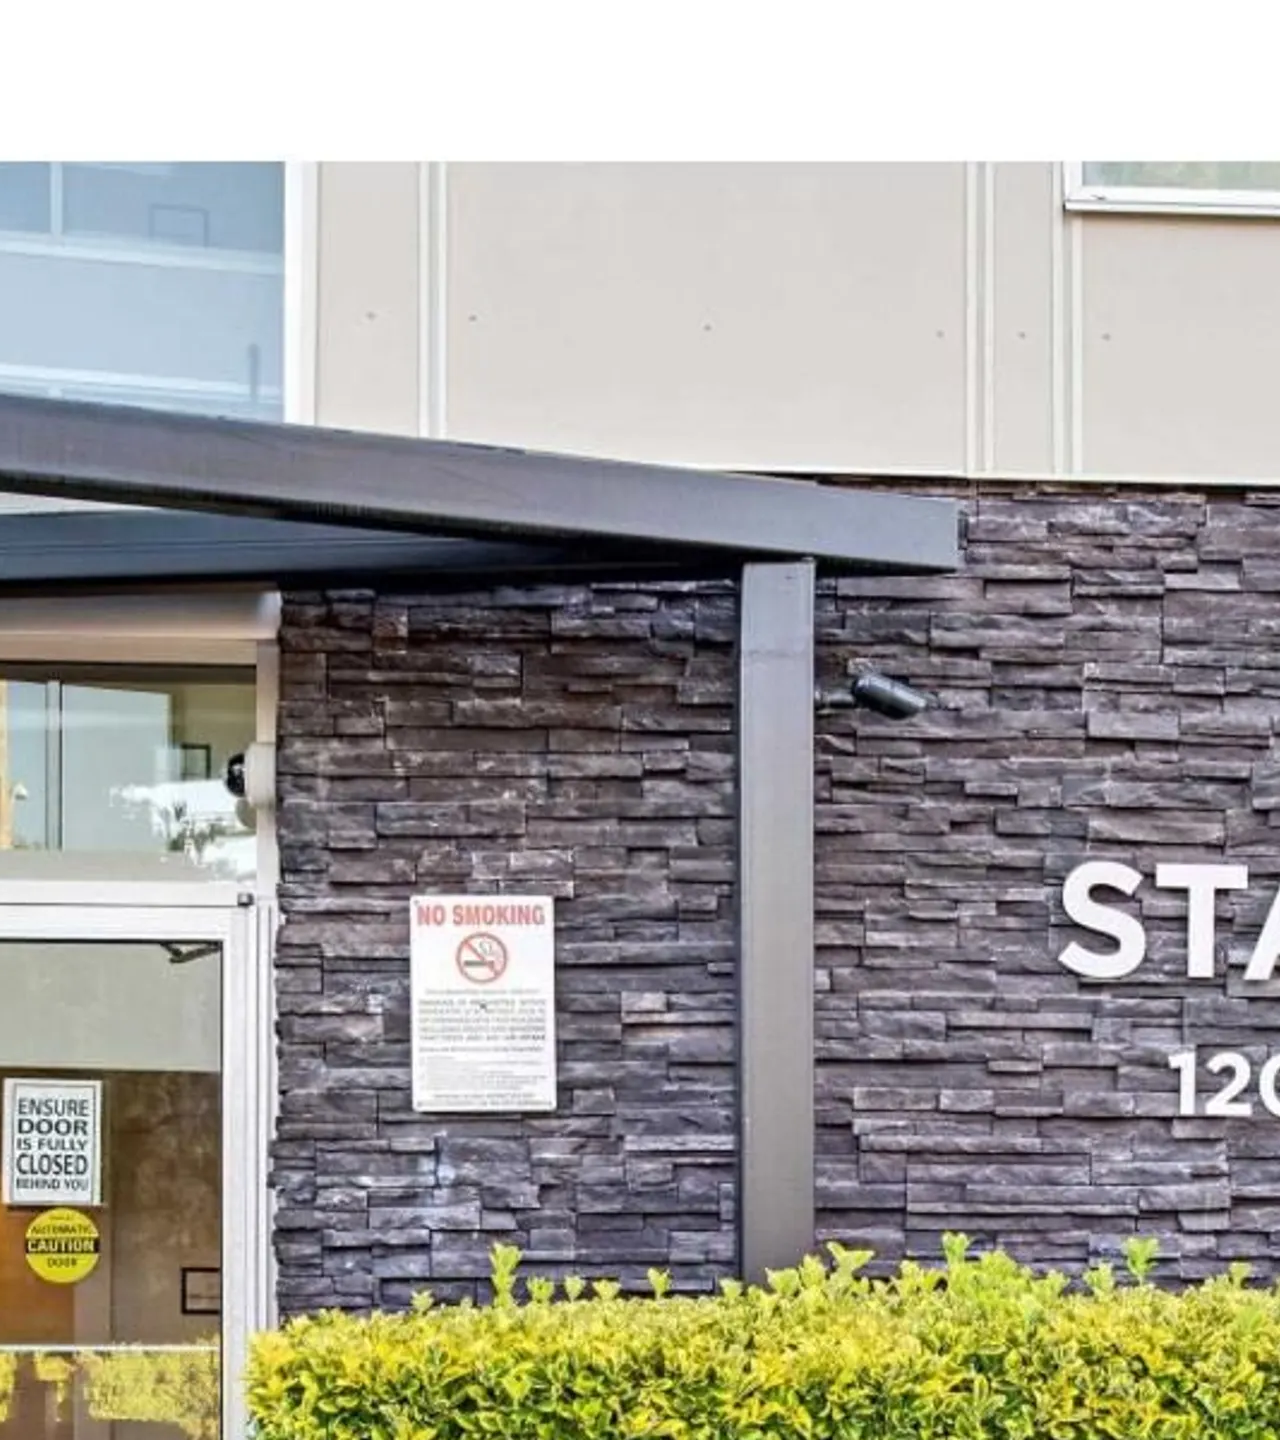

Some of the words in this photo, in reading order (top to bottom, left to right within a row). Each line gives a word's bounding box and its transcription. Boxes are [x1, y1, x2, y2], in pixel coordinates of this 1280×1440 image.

[416, 904, 446, 926] NO
[452, 904, 545, 926] SMOKING
[17, 1097, 90, 1117] ENSURE
[17, 1118, 89, 1136] DOOR
[16, 1138, 32, 1151] IS
[37, 1138, 88, 1151] FULLY
[15, 1153, 89, 1175] CLOSED
[15, 1177, 61, 1190] BEHIND
[63, 1177, 89, 1191] YOU
[27, 1238, 95, 1252] CAUTION
